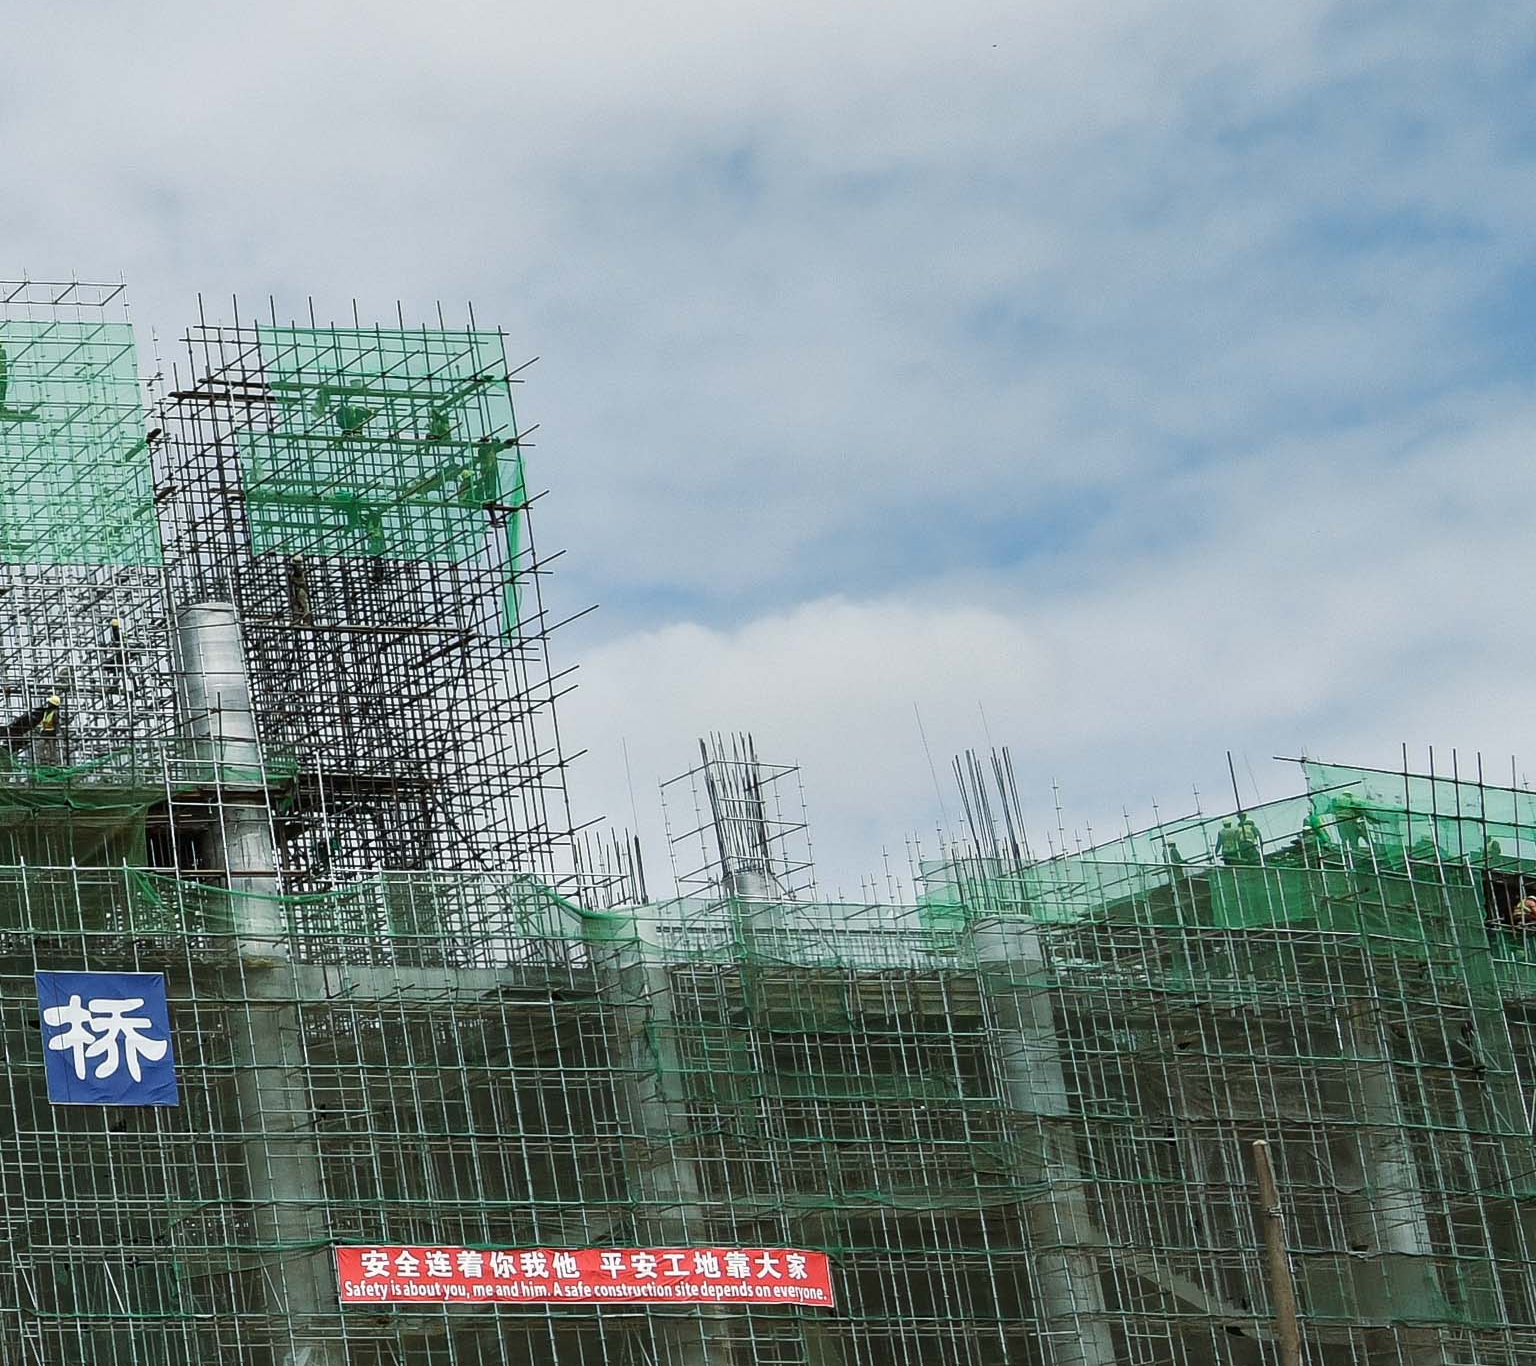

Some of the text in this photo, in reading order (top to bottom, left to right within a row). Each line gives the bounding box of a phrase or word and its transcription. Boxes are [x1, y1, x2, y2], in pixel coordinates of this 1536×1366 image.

[361, 1250, 809, 1280] 安全连着你我他 平安工地靠大家
[345, 1281, 827, 1301] Safety is about you, me and him. A safe construction site depends on everyone.
